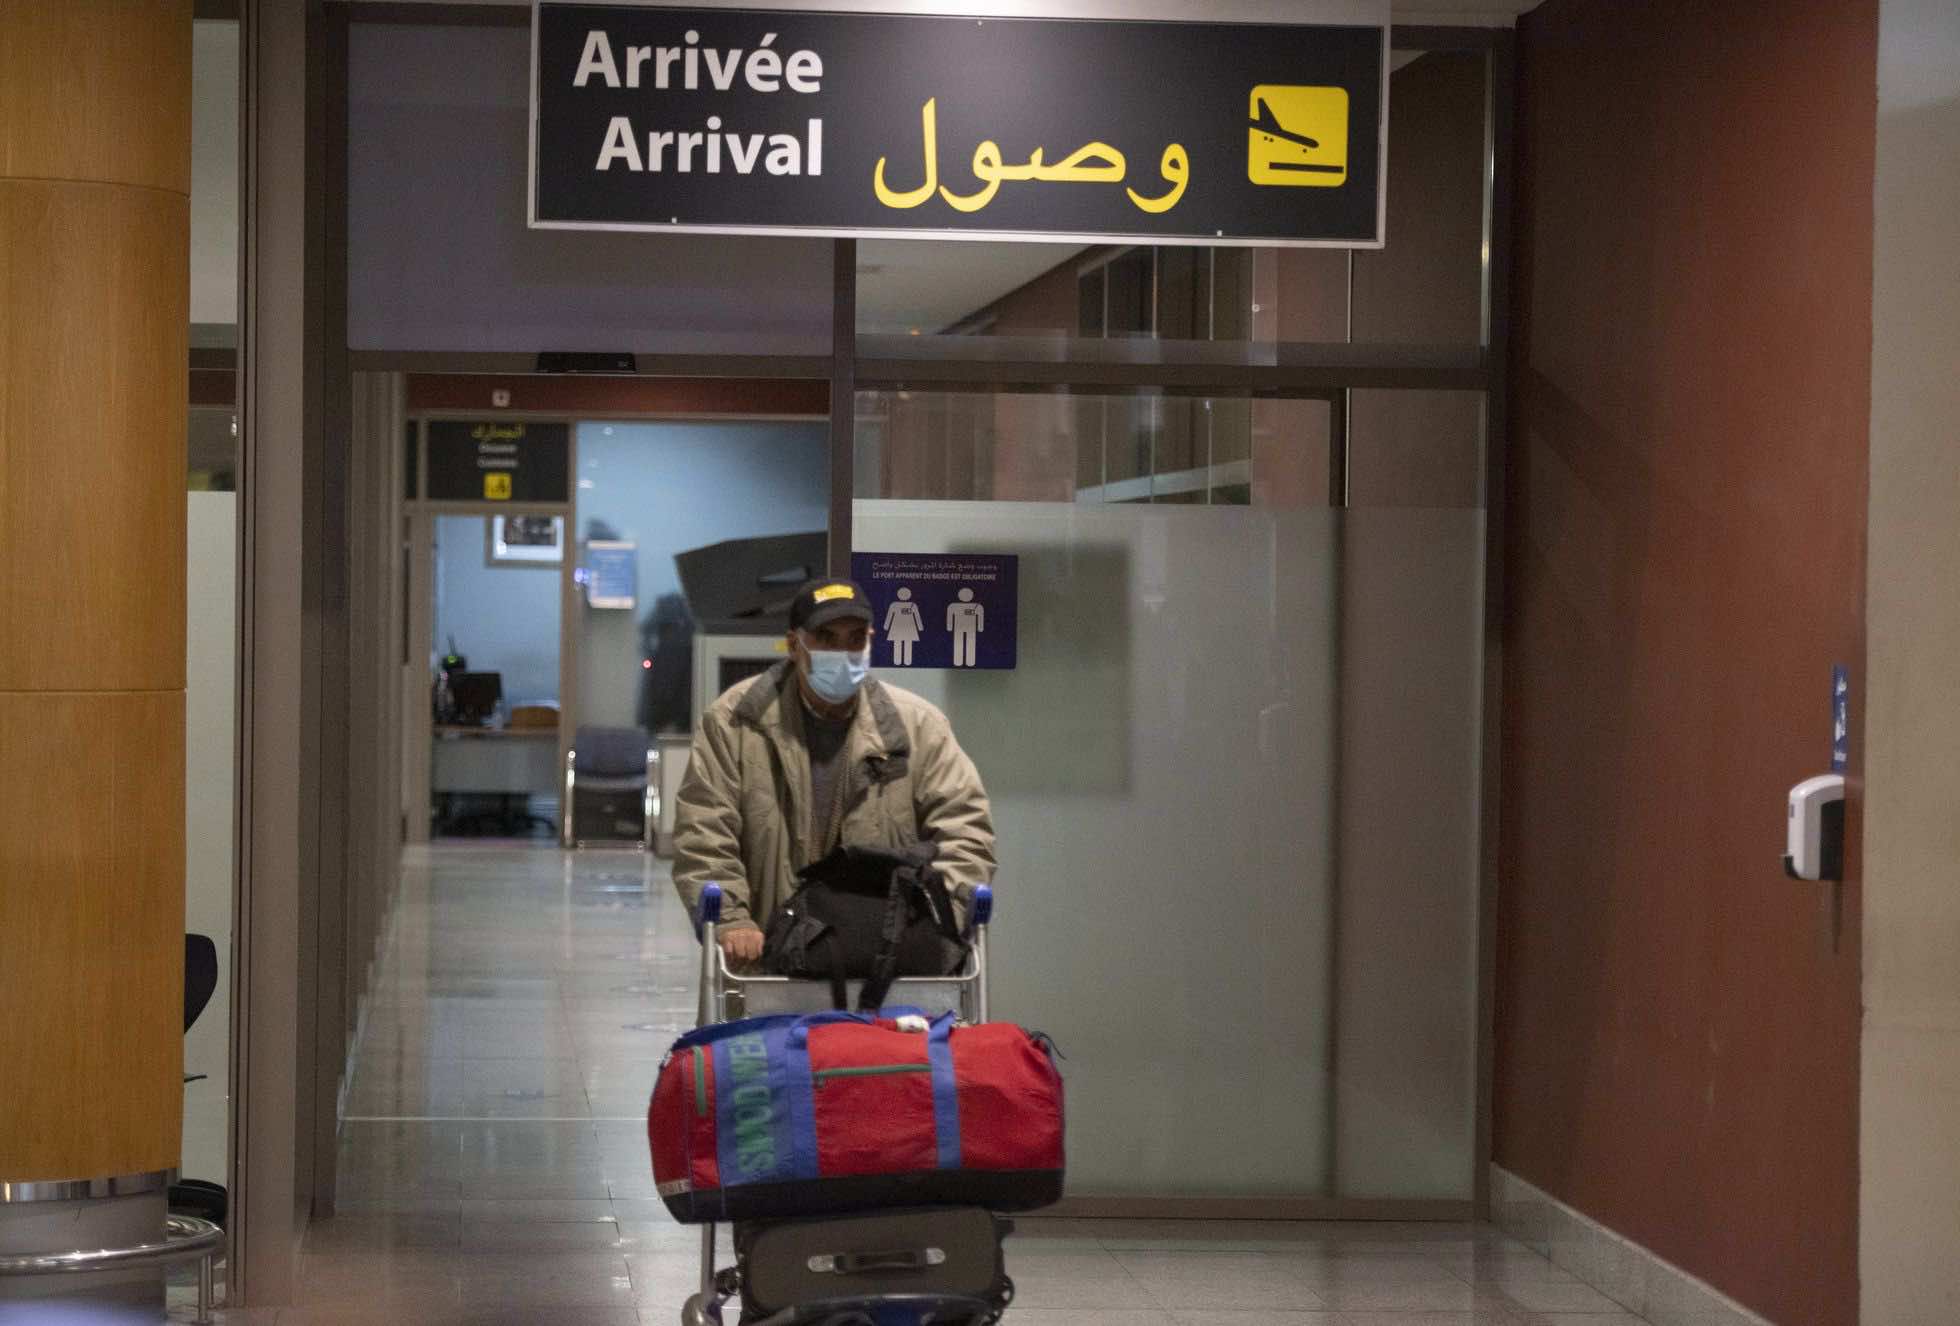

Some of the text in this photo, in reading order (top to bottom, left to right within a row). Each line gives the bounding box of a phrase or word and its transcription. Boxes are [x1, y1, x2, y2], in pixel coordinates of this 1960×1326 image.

[573, 30, 823, 93] Arrivée
[596, 116, 822, 176] Arrival
[873, 97, 1190, 214] وصول
